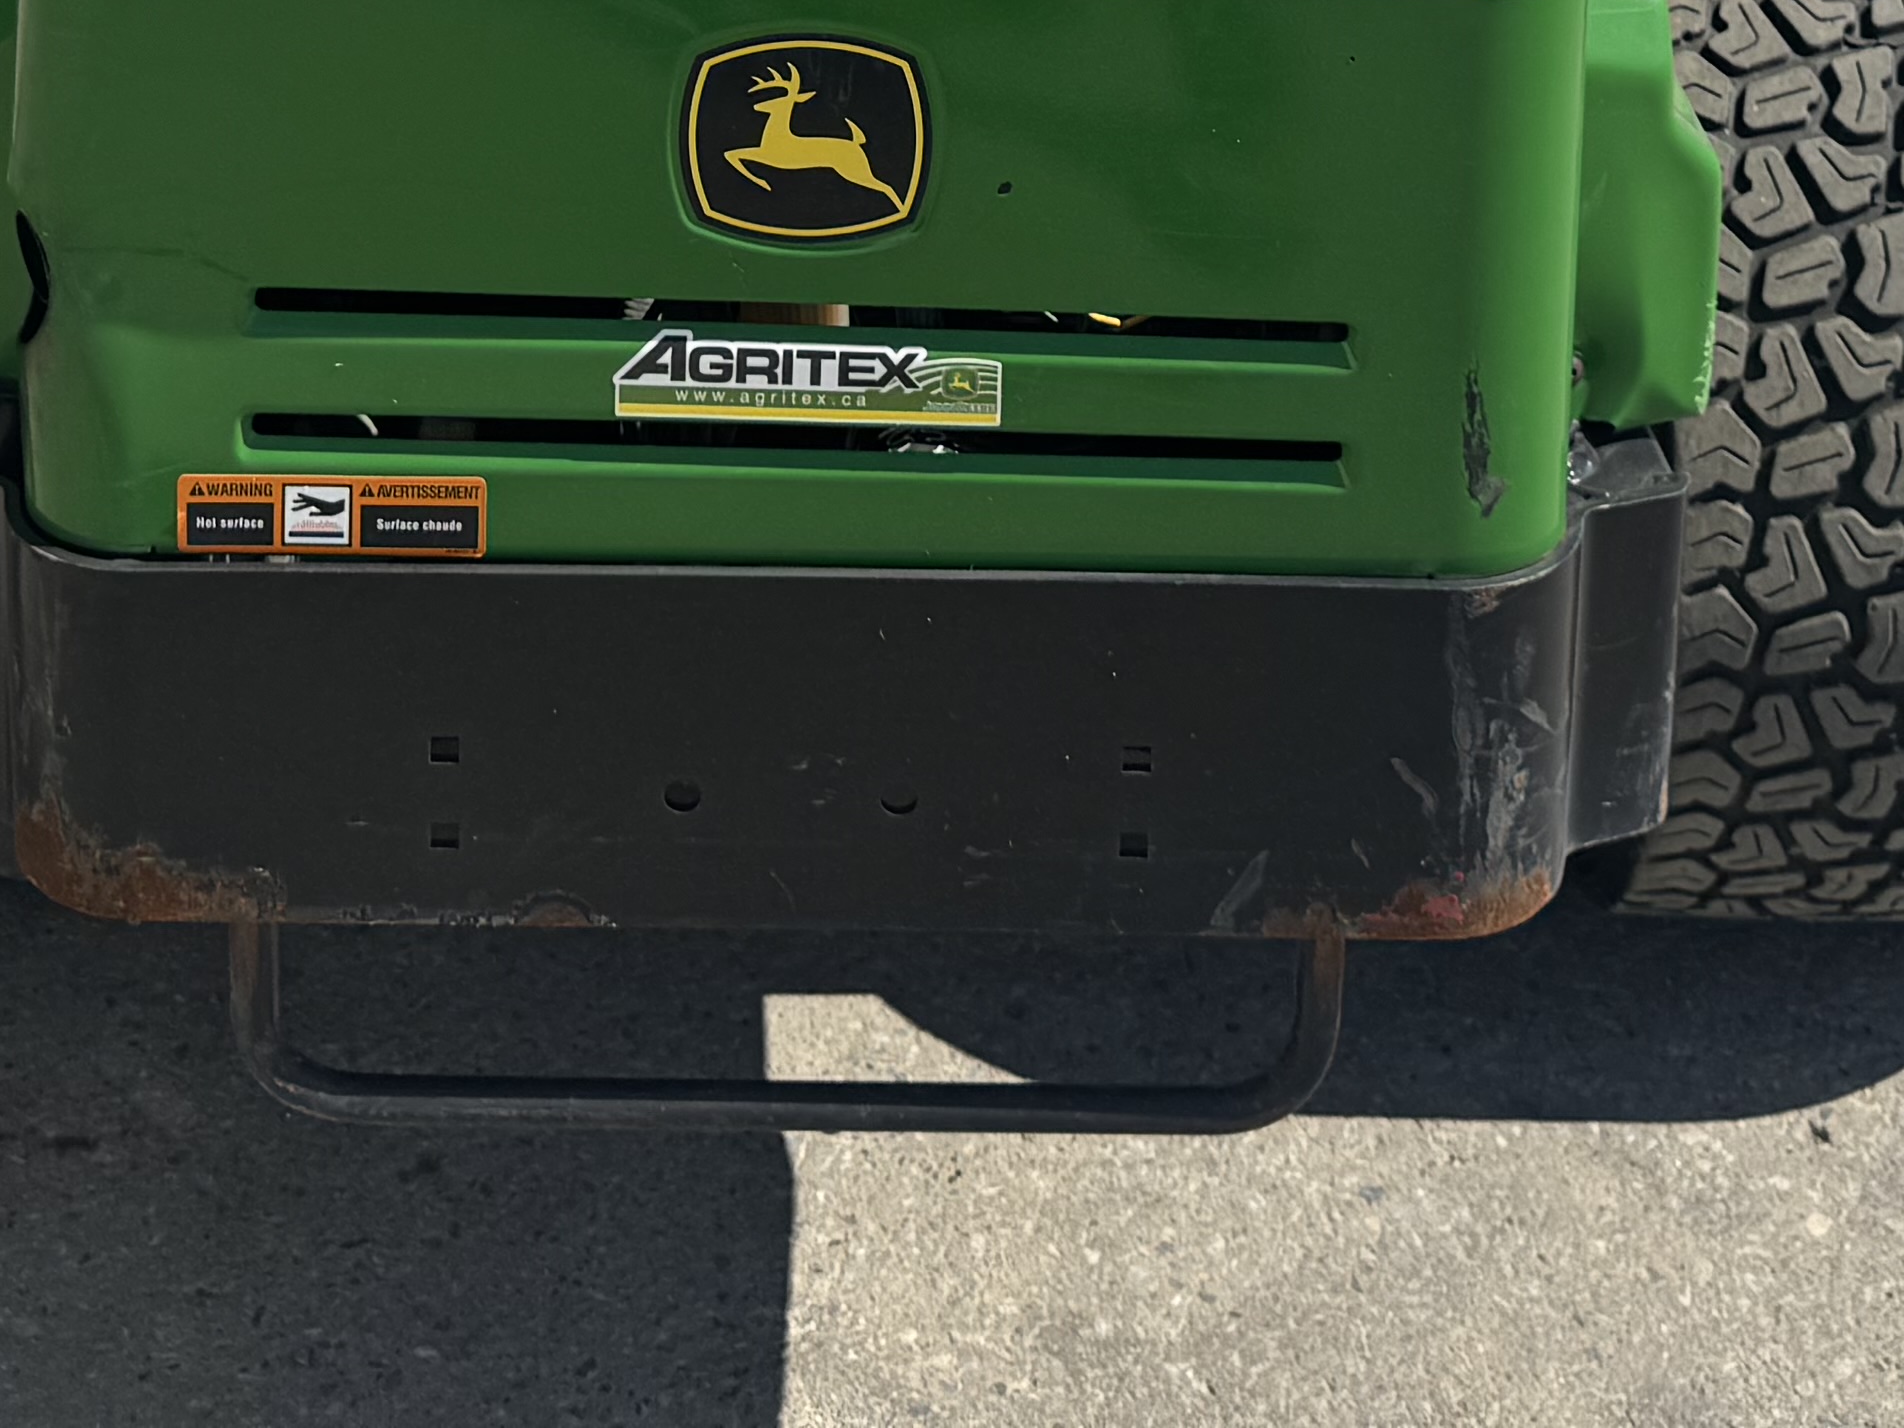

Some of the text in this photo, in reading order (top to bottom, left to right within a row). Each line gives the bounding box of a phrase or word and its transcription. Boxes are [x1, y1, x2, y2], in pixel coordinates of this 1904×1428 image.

[621, 334, 922, 389] AGRITEX
[675, 388, 867, 408] www.agritex.ca
[206, 482, 274, 497] WARNING
[377, 484, 481, 500] AVERTISSEMENT
[196, 516, 264, 529] Hot surface
[376, 518, 463, 531] Surface chaude
